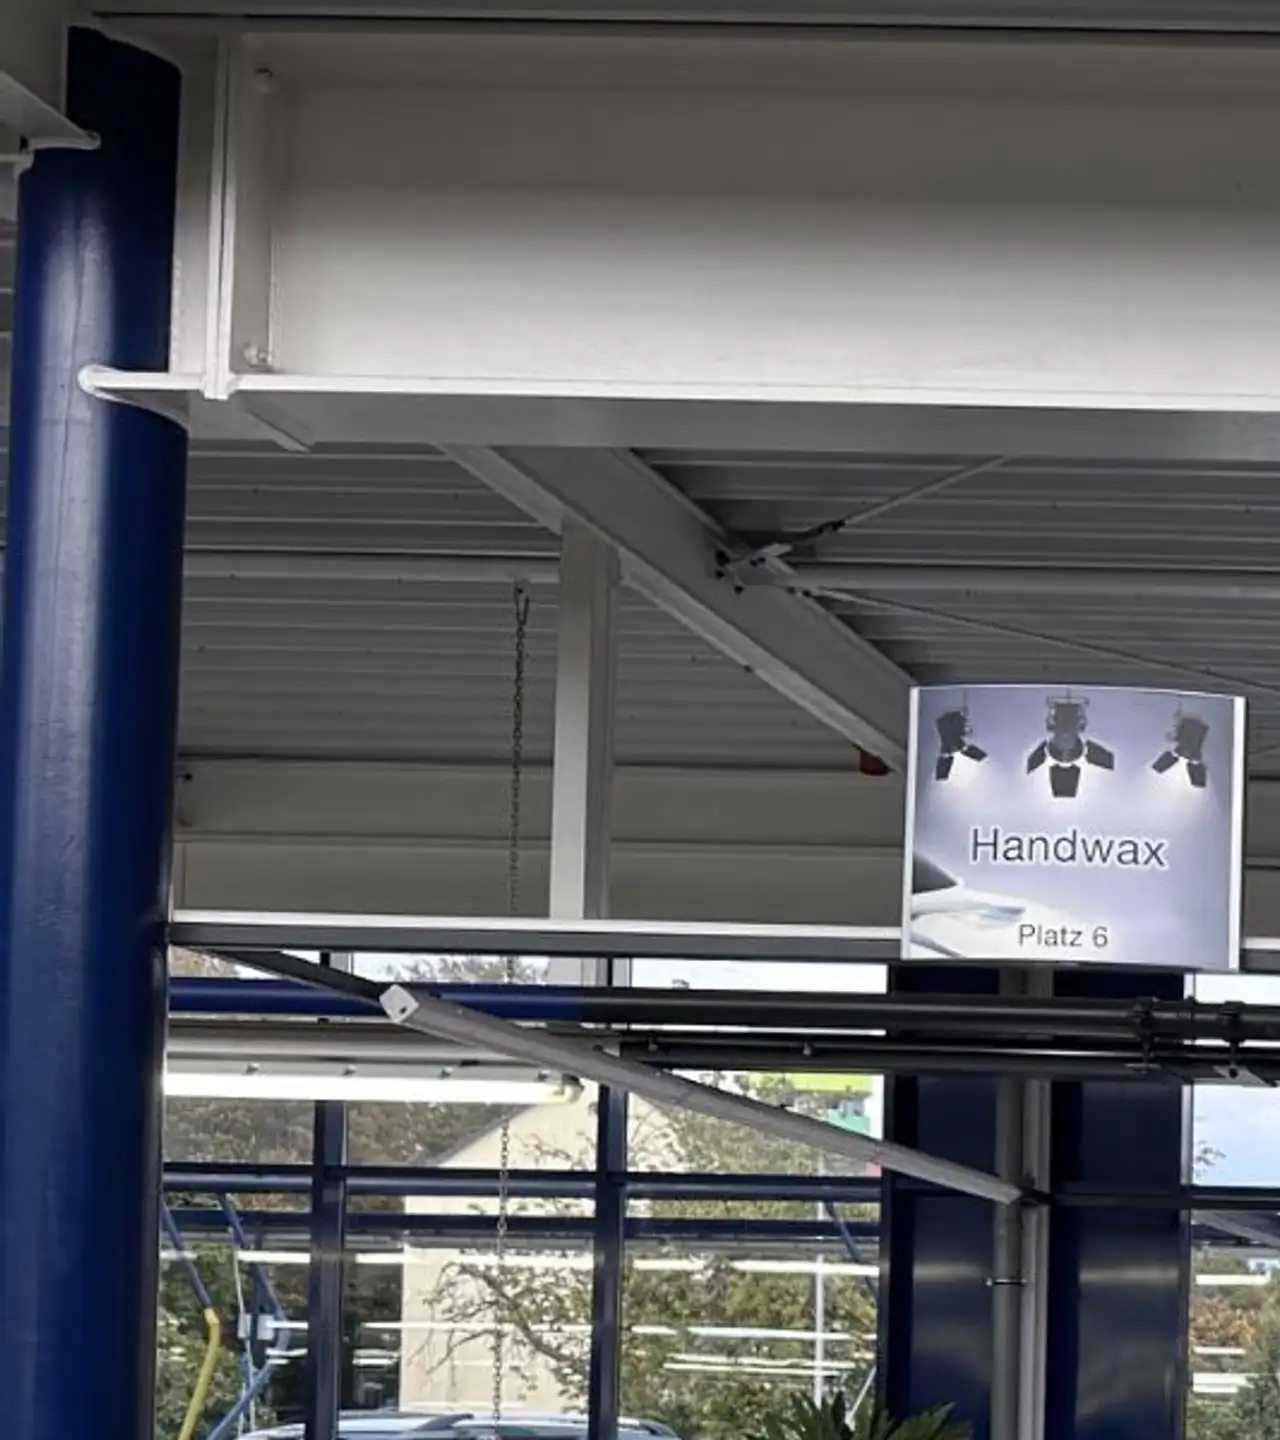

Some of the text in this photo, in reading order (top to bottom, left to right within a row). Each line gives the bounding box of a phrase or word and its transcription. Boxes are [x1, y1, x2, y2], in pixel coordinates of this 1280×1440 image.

[970, 828, 1167, 867] Handwax
[1018, 925, 1108, 948] Platz 6
